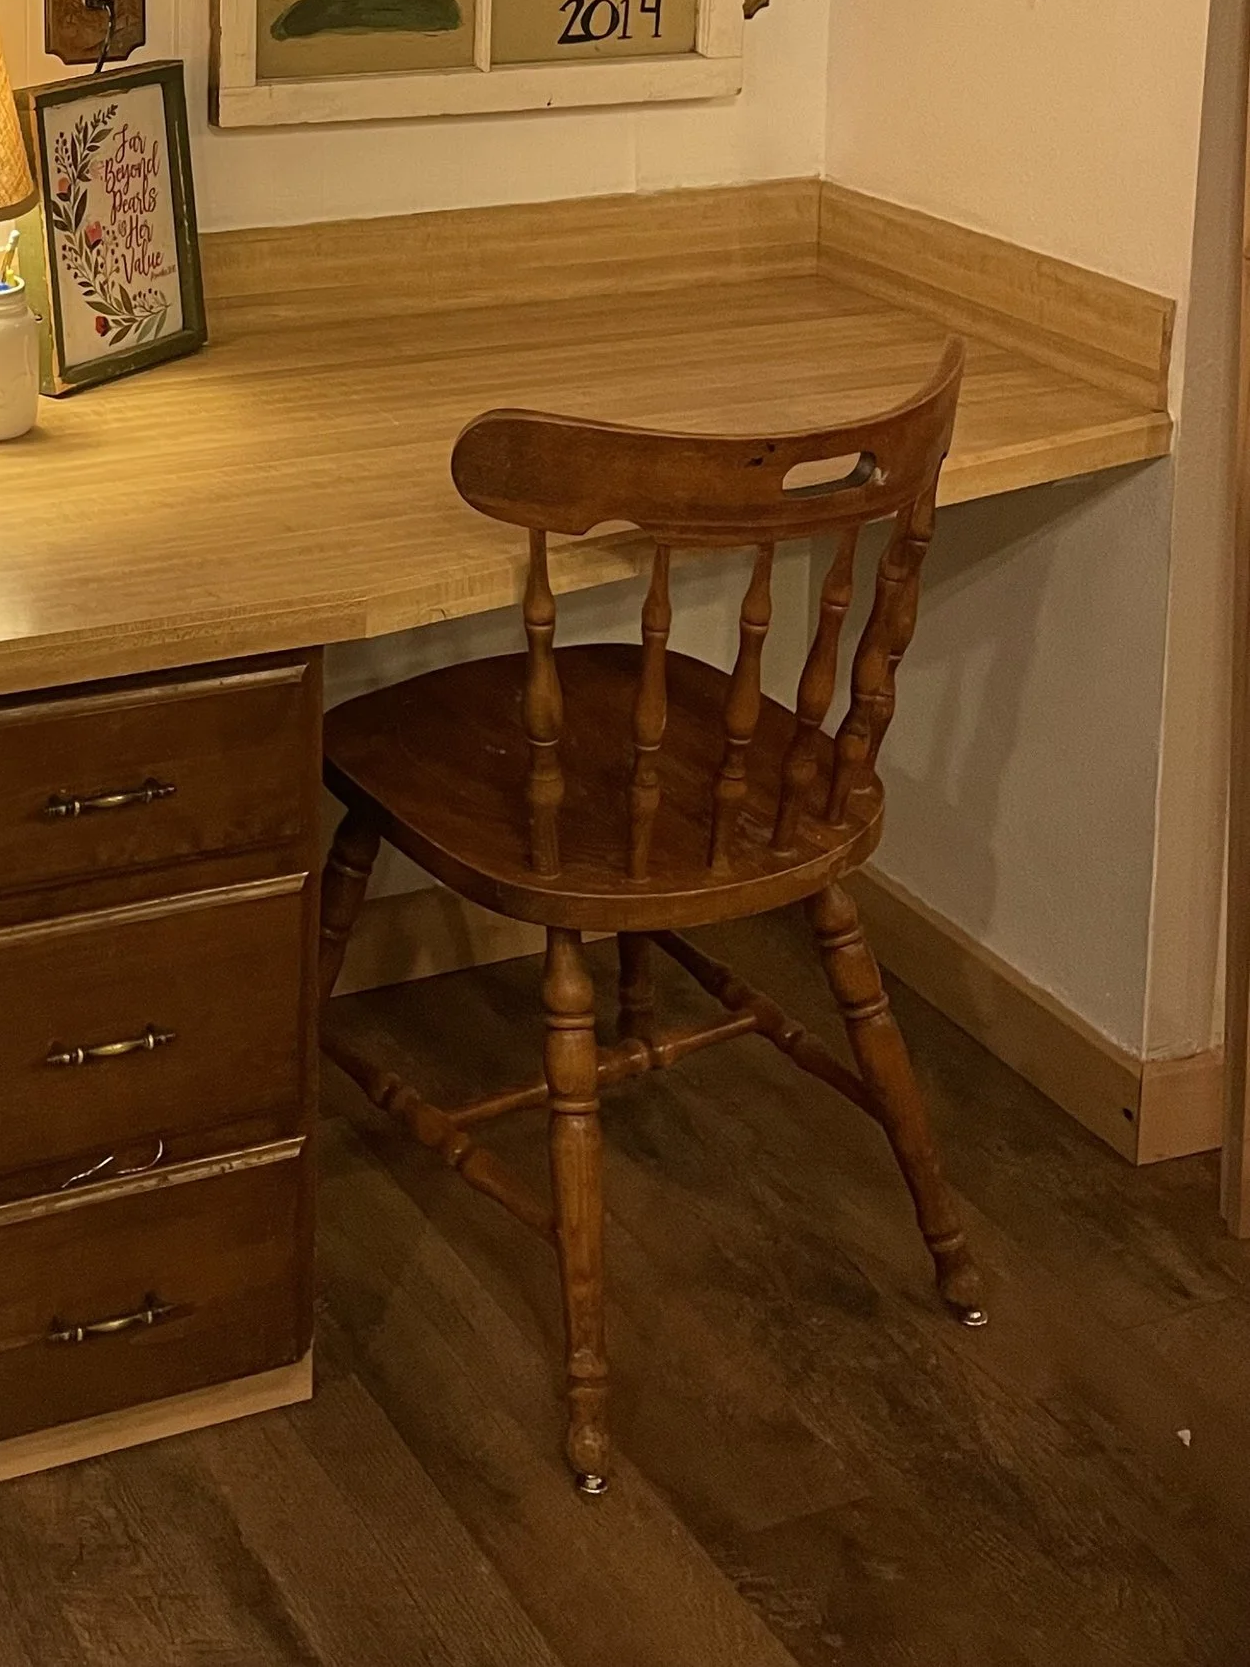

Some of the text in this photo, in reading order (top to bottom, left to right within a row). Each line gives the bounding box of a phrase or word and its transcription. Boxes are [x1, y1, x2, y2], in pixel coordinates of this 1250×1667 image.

[112, 123, 147, 164] Far
[104, 140, 160, 195] Beyond
[111, 175, 158, 225] Pearls
[125, 214, 154, 249] Her
[121, 238, 164, 284] Value
